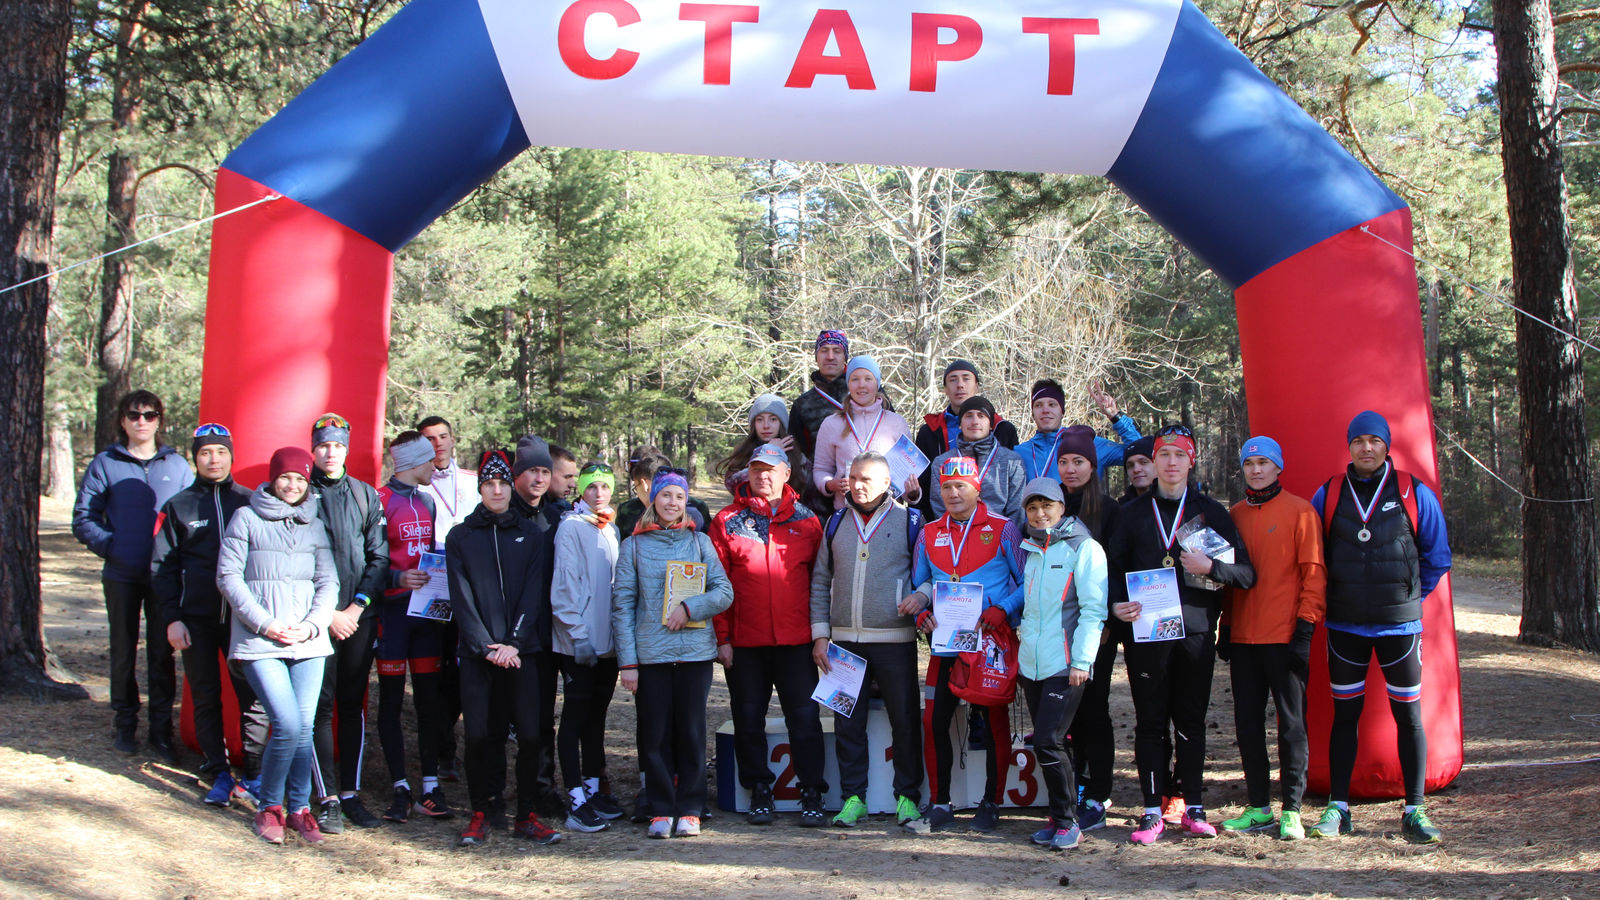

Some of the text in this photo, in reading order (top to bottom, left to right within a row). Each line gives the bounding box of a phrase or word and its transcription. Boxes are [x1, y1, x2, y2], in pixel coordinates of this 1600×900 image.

[557, 0, 1100, 96] СТАРТ
[402, 523, 431, 538] Silence
[770, 743, 802, 801] 2
[1007, 749, 1039, 807] 3
